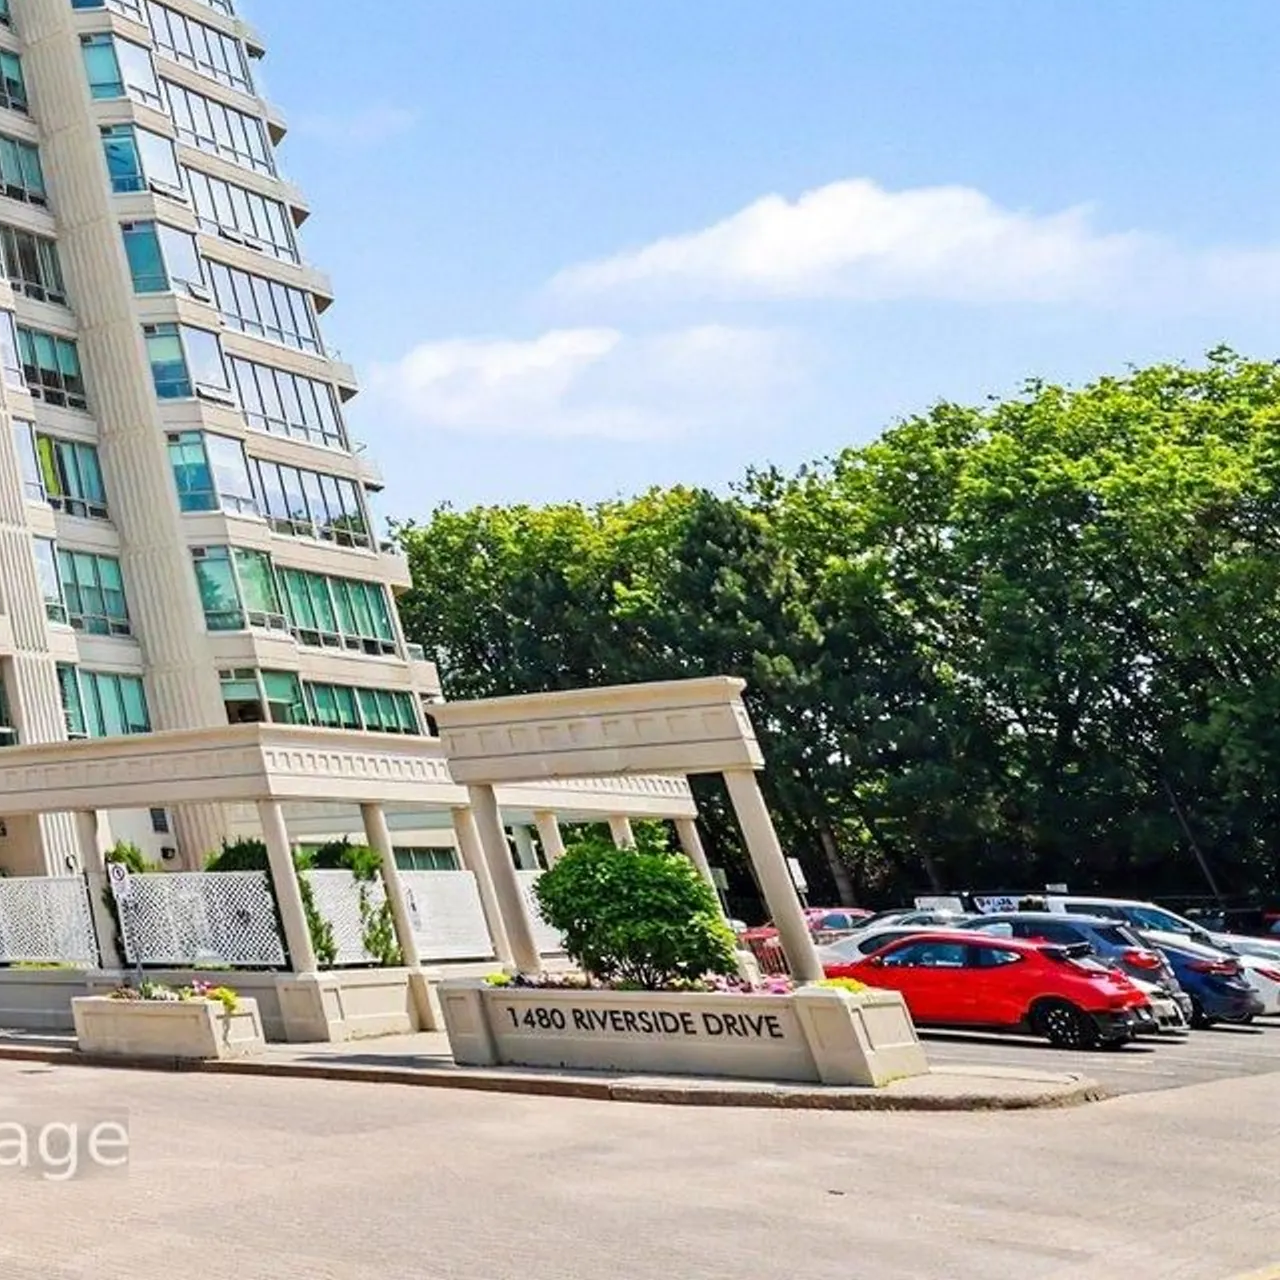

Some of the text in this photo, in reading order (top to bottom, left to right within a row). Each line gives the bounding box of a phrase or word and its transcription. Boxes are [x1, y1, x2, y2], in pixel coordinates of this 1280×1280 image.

[506, 1006, 784, 1039] 1480 RIVERSIDE DRIVE
